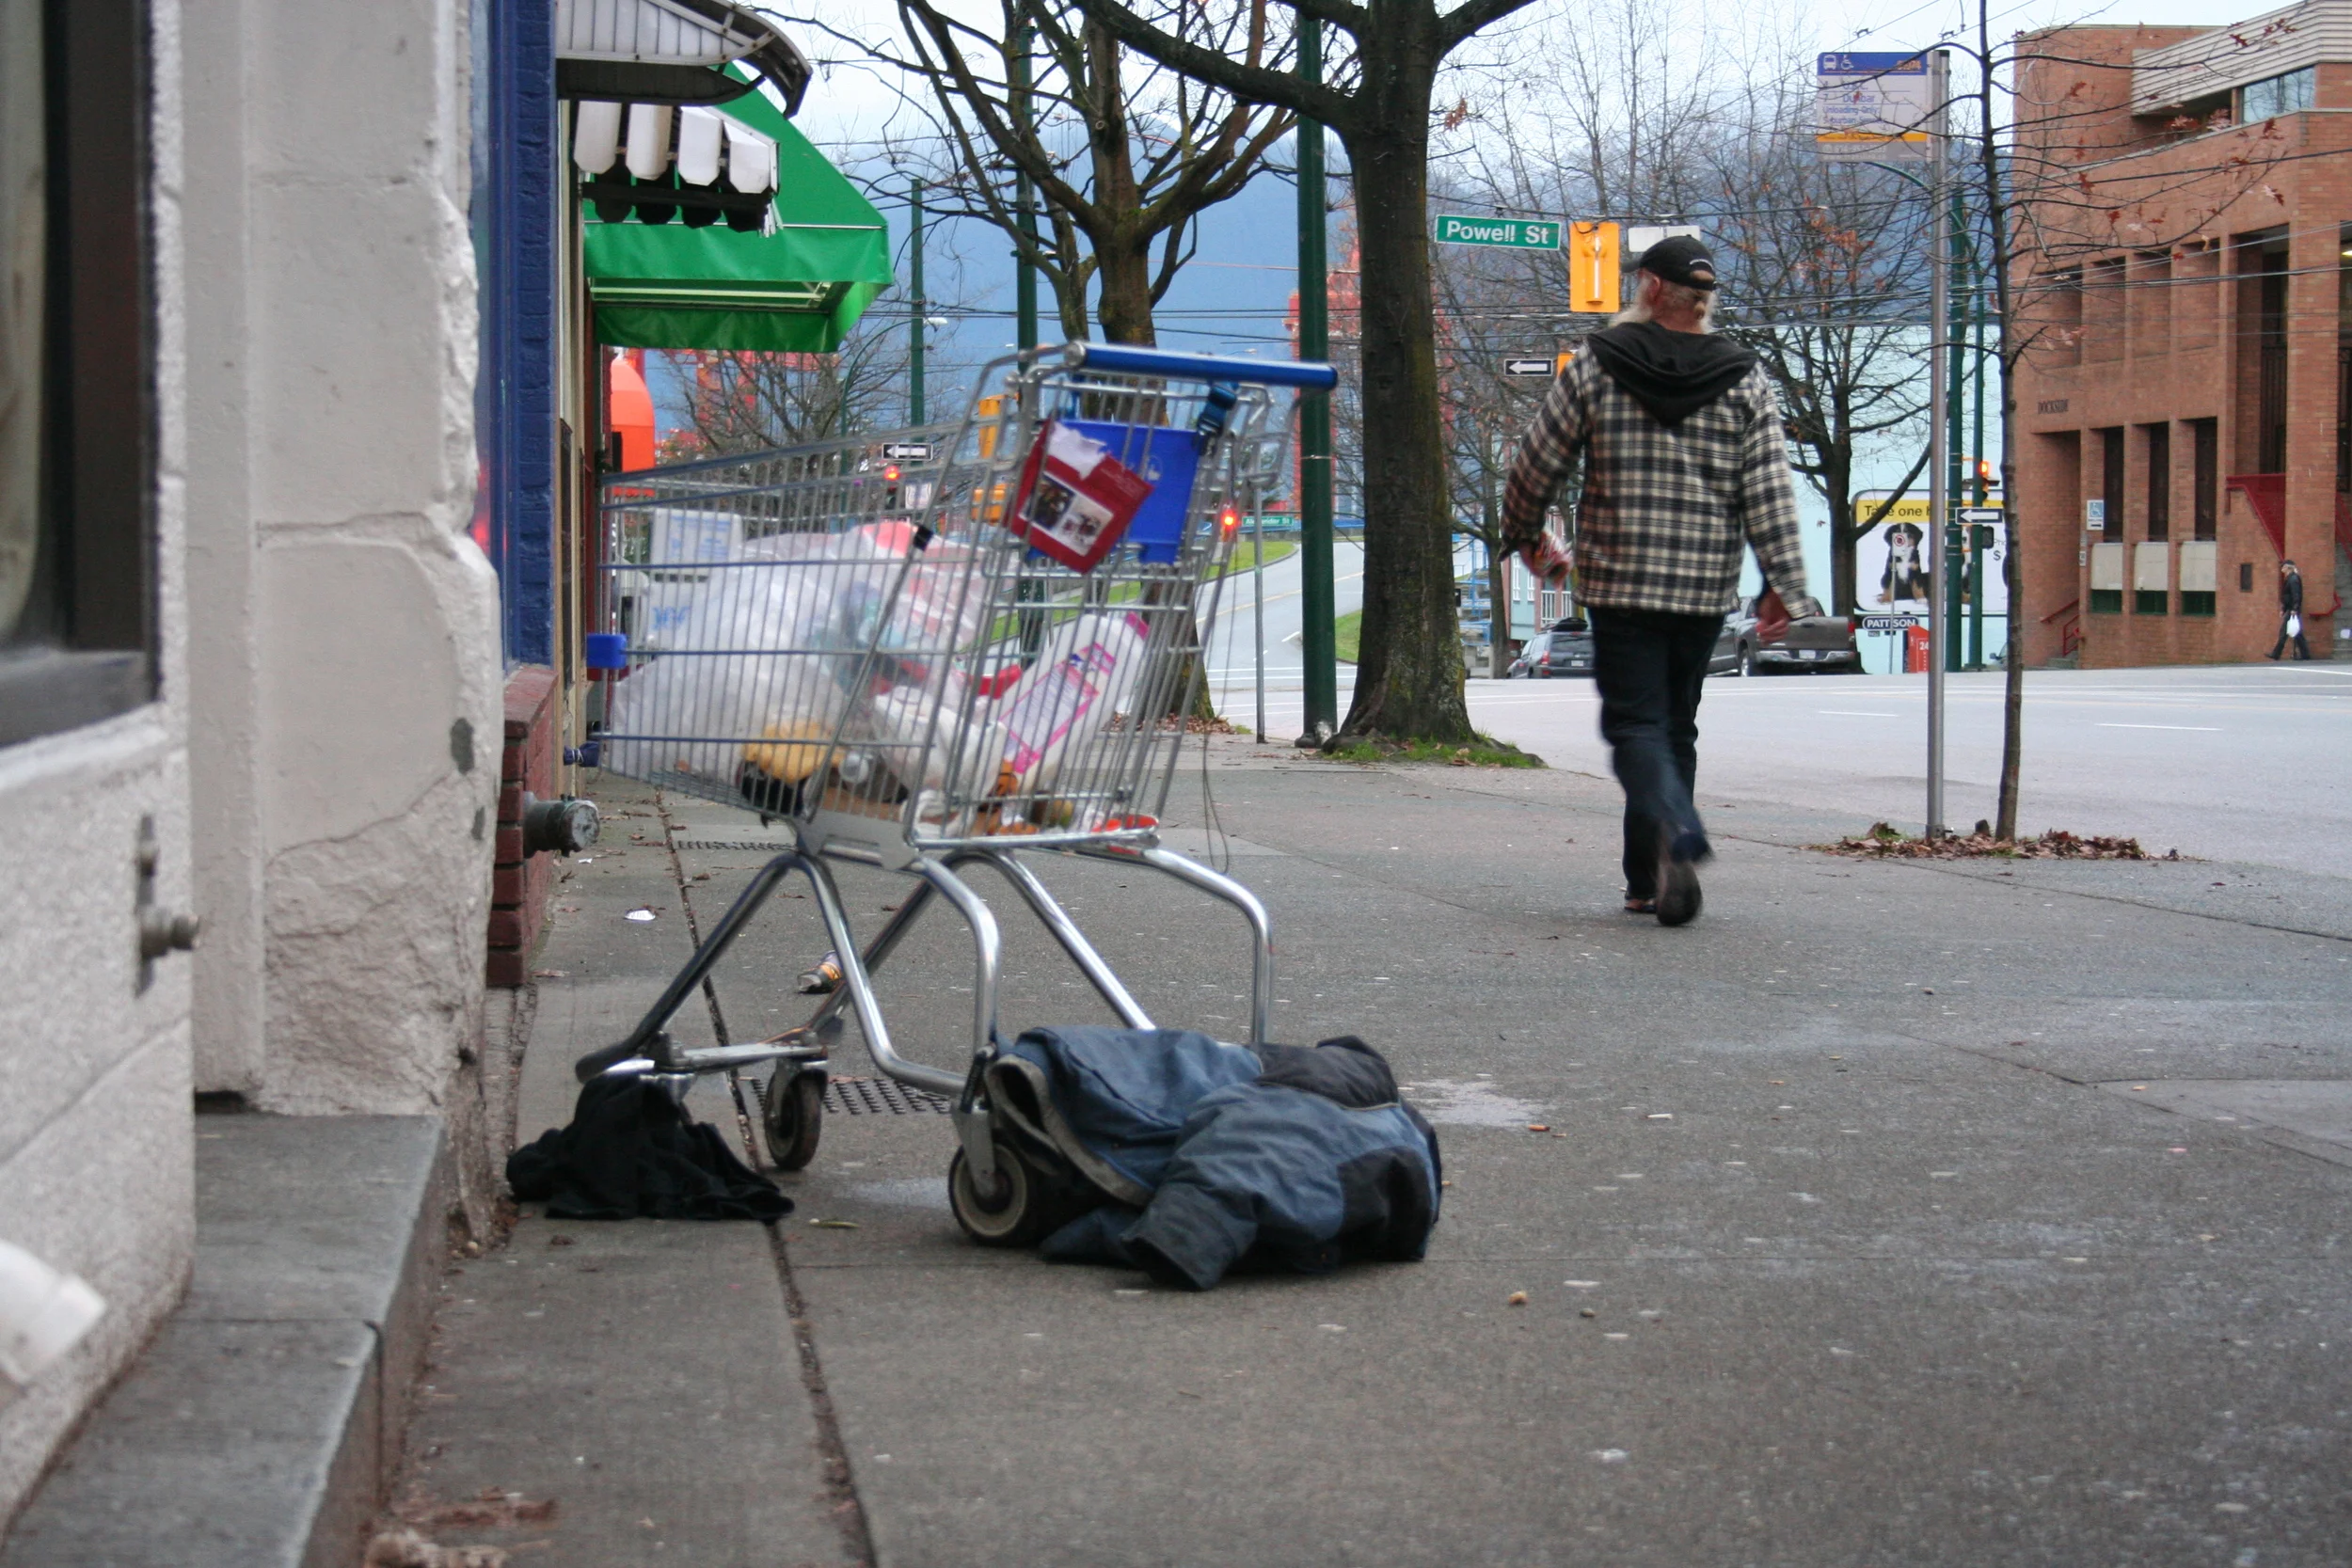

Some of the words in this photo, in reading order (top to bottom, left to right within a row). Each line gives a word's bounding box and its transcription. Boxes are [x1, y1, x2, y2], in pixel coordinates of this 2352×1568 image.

[1843, 95, 1875, 103] Dubar
[1446, 220, 1517, 243] Powell
[1524, 225, 1549, 245] St
[1864, 505, 1895, 516] Tae
[1899, 508, 1922, 516] one
[1867, 619, 1916, 628] PATTSON
